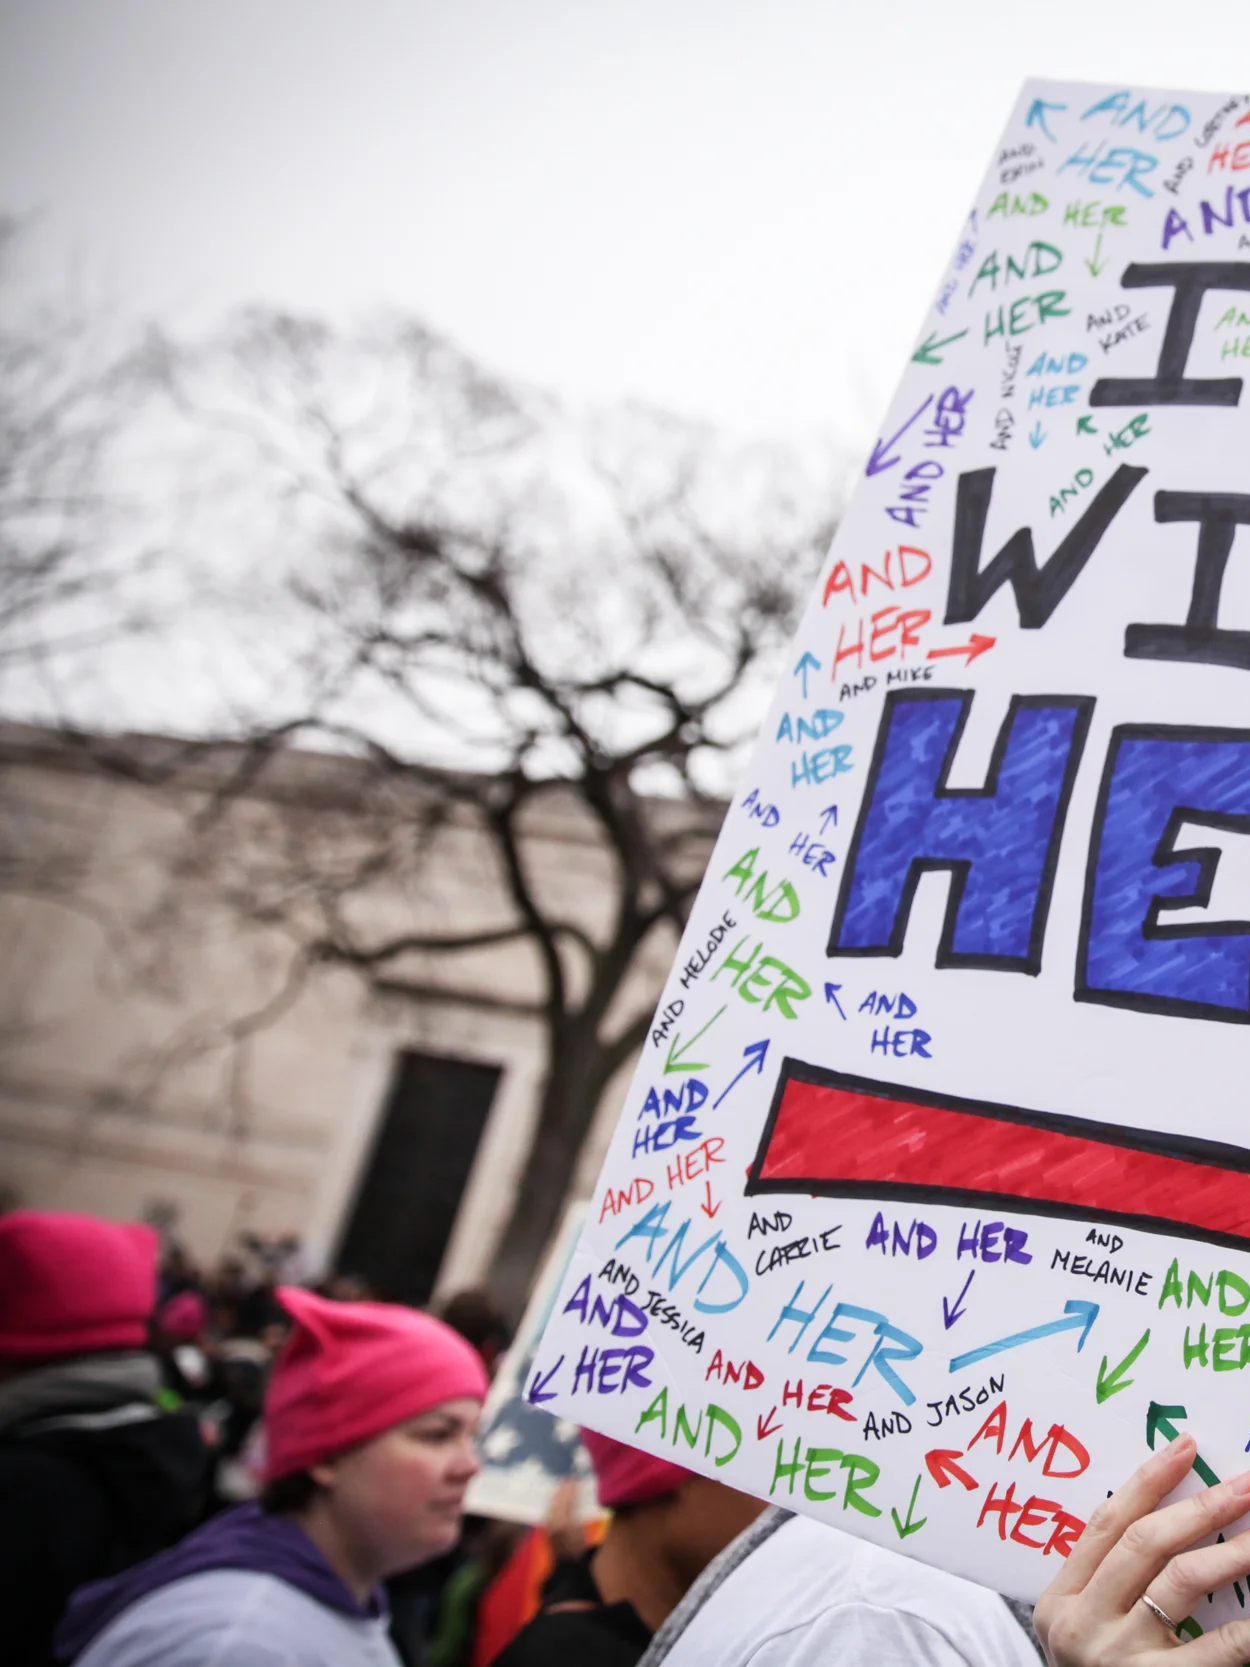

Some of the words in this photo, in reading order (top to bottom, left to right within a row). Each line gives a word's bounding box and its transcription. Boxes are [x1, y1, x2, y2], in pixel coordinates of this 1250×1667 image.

[1080, 90, 1191, 142] AND
[1056, 140, 1159, 199] HER
[986, 191, 1050, 219] AND
[1063, 201, 1128, 228] HER
[968, 240, 1063, 297] AND
[984, 290, 1072, 347] HER
[1086, 305, 1131, 332] AND
[1098, 313, 1150, 355] KATE
[1025, 351, 1089, 377] AND
[1028, 384, 1081, 411] HER
[885, 460, 945, 528] AND
[924, 385, 975, 448] HER
[1050, 469, 1093, 516] AND
[1104, 412, 1151, 456] HER
[822, 545, 933, 608] AND
[831, 606, 934, 685] HER
[839, 676, 877, 702] AND
[887, 666, 932, 685] MIKE
[776, 708, 845, 744] AND
[791, 744, 854, 789] HER
[741, 788, 780, 828] AND
[789, 832, 836, 878] HER
[722, 847, 800, 923] AND
[652, 1000, 684, 1048] AND
[680, 911, 736, 989] MELODIE
[710, 935, 812, 1020] HER
[858, 991, 917, 1019] AND
[871, 1025, 932, 1058] HER
[637, 1078, 709, 1121] AND
[632, 1115, 703, 1158] HER
[599, 1177, 654, 1224] AND
[667, 1137, 725, 1190] HER
[748, 1211, 792, 1240] AND
[865, 1211, 937, 1260] AND
[957, 1220, 1033, 1265] HER
[1086, 1229, 1123, 1254] AND
[1051, 1249, 1153, 1296] MELANIE
[562, 1273, 648, 1337] AND
[599, 1258, 641, 1296] AND
[641, 1291, 708, 1353] JESSICA
[615, 1200, 748, 1313] AND
[767, 1280, 923, 1408] HER
[571, 1345, 655, 1396] HER
[705, 1349, 765, 1390] AND
[782, 1379, 858, 1421] HER
[863, 1411, 912, 1441] AND
[927, 1374, 1004, 1427] JASON
[635, 1386, 742, 1467] AND
[769, 1436, 882, 1518] HER
[967, 1400, 1090, 1478] AND
